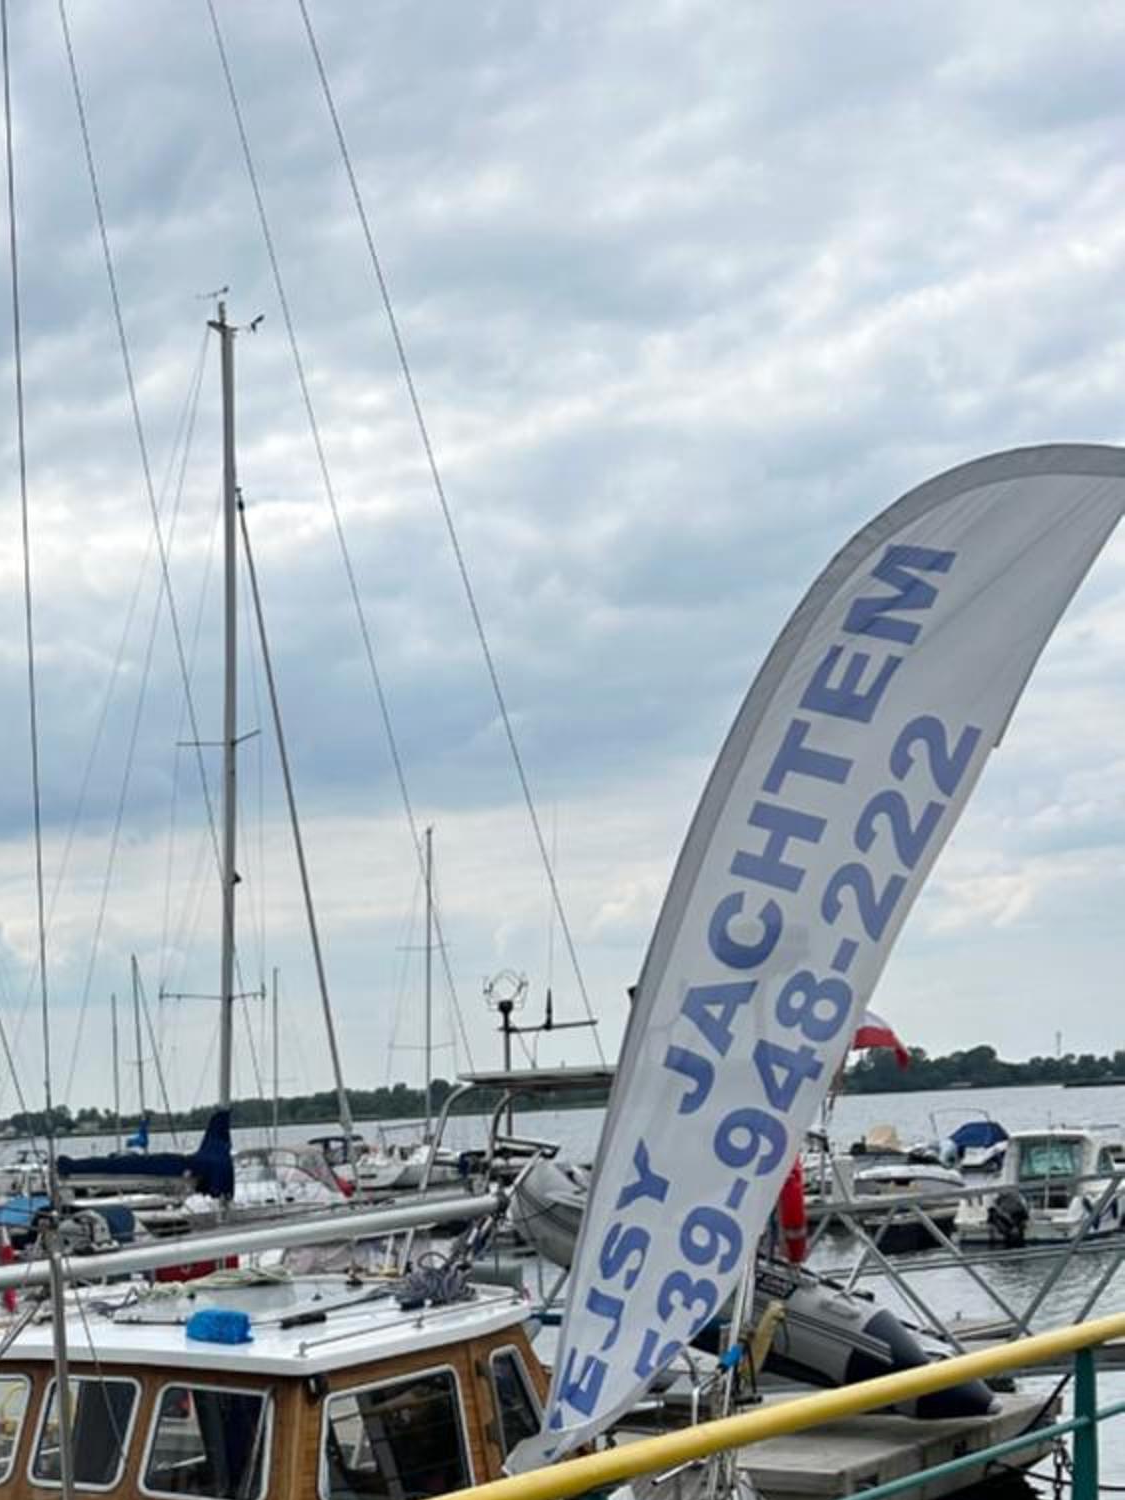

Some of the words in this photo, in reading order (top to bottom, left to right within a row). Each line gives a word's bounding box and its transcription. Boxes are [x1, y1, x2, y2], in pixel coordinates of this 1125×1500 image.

[548, 1137, 671, 1430] EJSY
[664, 544, 957, 1115] JACHTEM
[634, 715, 981, 1379] 539-948-222
